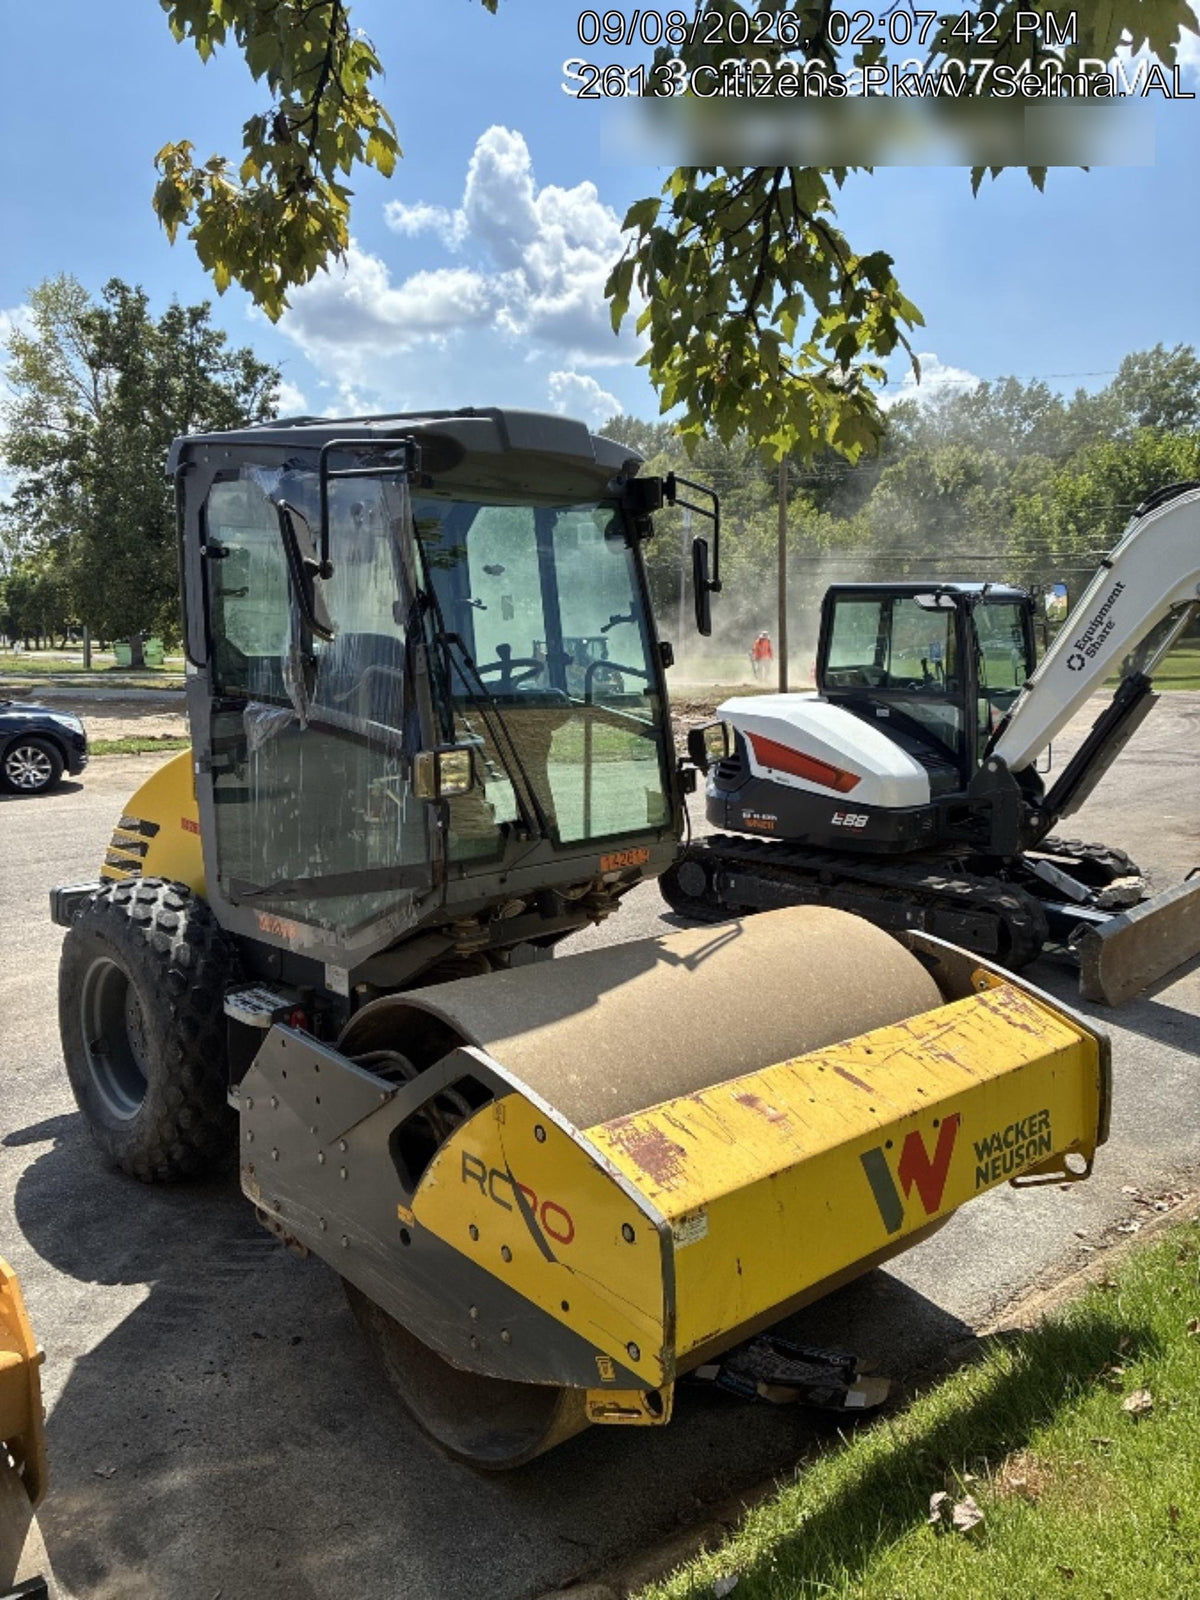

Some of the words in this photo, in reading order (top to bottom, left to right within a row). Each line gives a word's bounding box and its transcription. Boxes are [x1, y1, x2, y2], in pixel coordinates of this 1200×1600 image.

[1073, 580, 1126, 651] Equipment
[1085, 620, 1116, 659] Share
[973, 1108, 1052, 1163] WACKER
[975, 1130, 1053, 1190] NEUSON
